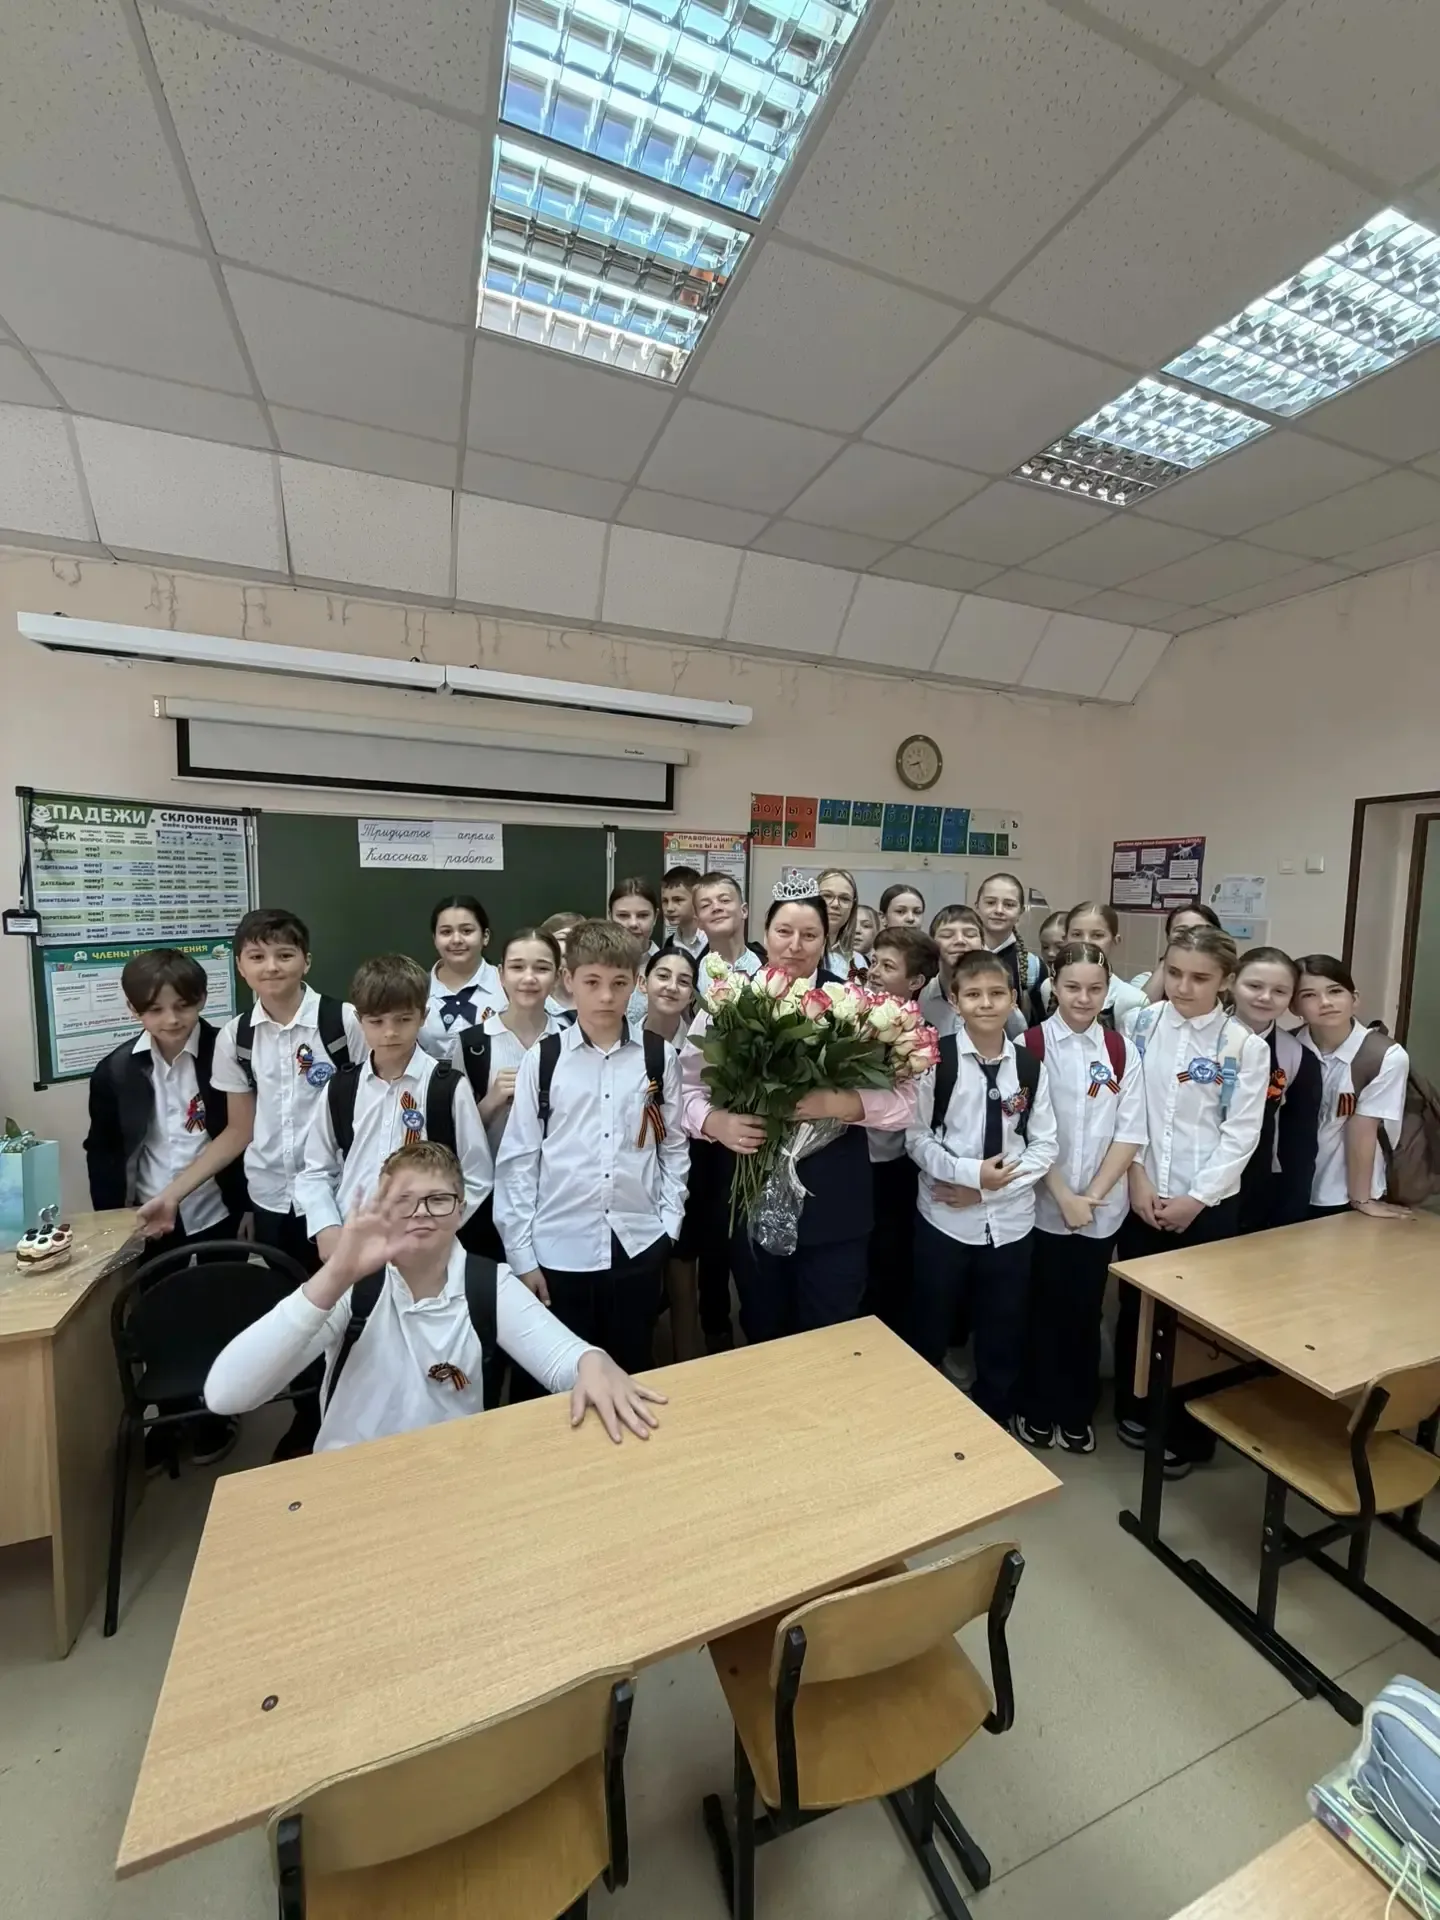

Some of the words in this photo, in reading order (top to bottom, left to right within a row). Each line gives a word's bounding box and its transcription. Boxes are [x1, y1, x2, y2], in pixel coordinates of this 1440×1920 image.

[53, 804, 147, 825] ПАДЕЖИ
[789, 807, 799, 815] ы
[186, 831, 193, 839] 2
[361, 824, 431, 841] Тридцатое
[457, 831, 496, 844] апреля
[365, 847, 429, 862] Классная
[443, 849, 495, 868] работа
[92, 951, 130, 959] ЧЛЕНЫ
